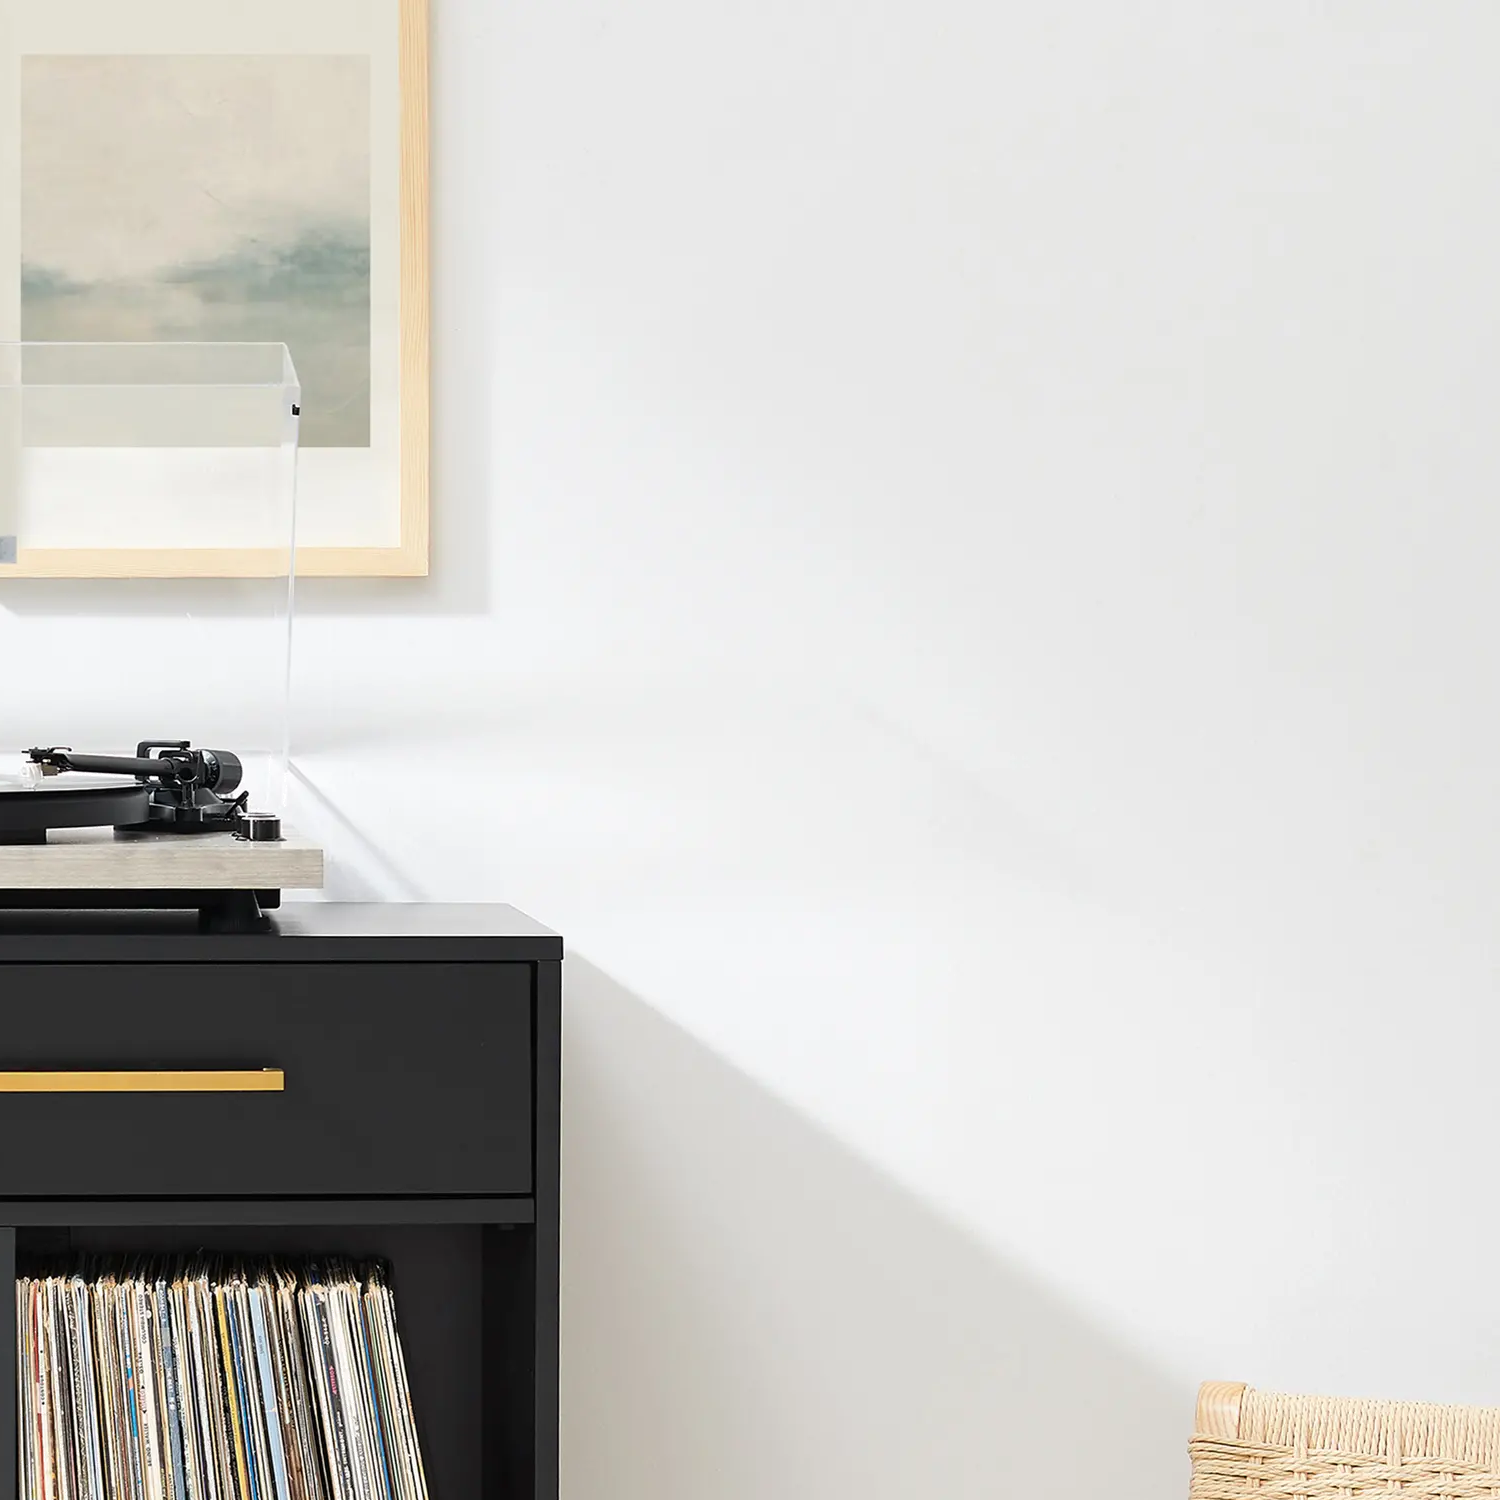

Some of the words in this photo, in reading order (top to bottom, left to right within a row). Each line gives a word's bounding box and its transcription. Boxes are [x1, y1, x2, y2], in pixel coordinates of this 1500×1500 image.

[136, 1293, 144, 1315] STEREO
[138, 1315, 147, 1344] COLUMBIA
[334, 1409, 343, 1428] piano
